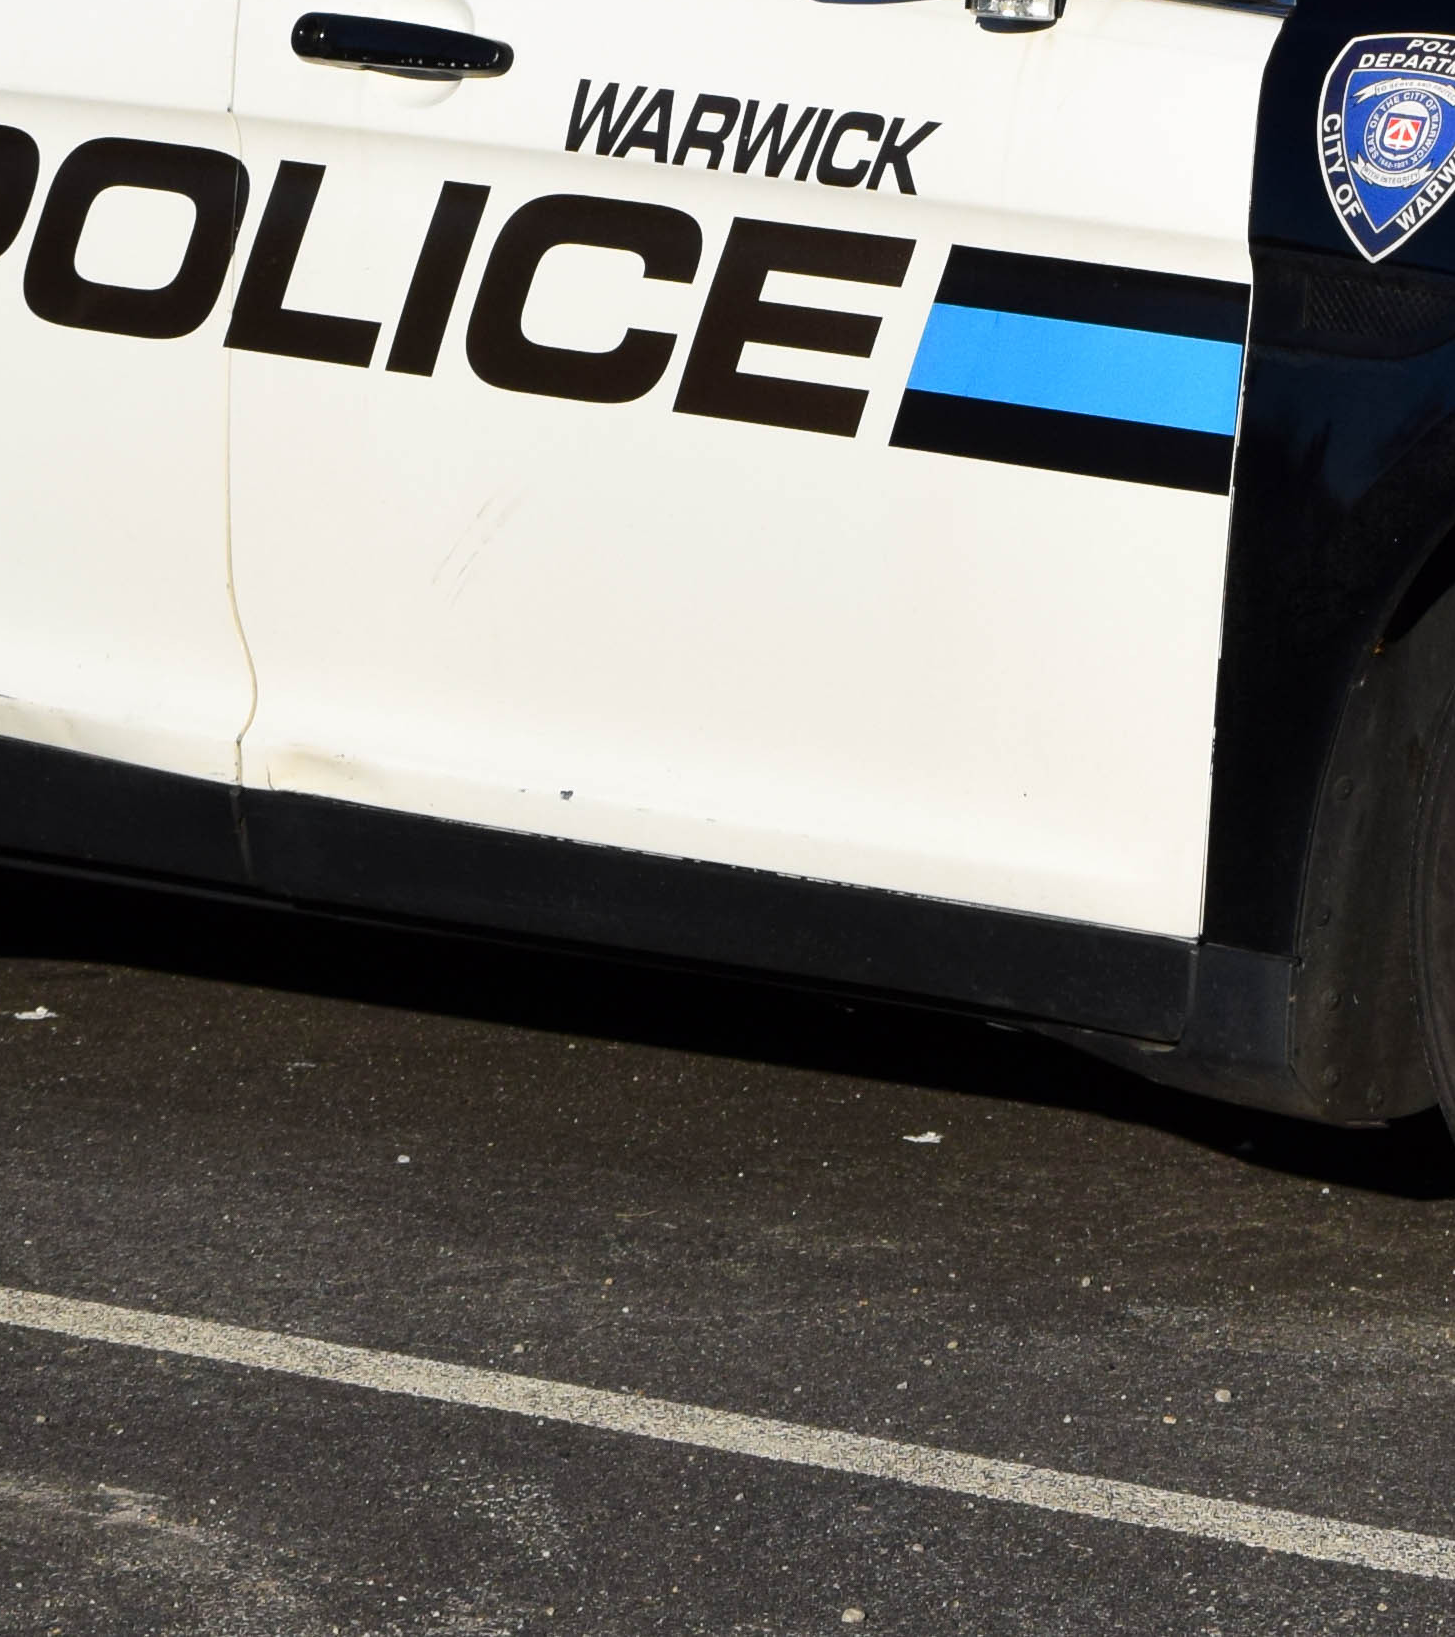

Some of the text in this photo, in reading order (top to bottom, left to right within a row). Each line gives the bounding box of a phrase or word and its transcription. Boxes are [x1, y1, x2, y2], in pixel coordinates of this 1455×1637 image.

[560, 77, 941, 195] WARWICK
[1369, 114, 1381, 128] OF
[1380, 95, 1401, 113] THE
[1403, 92, 1427, 103] CITY
[1425, 99, 1437, 112] OF
[1322, 114, 1363, 218] CITY OF
